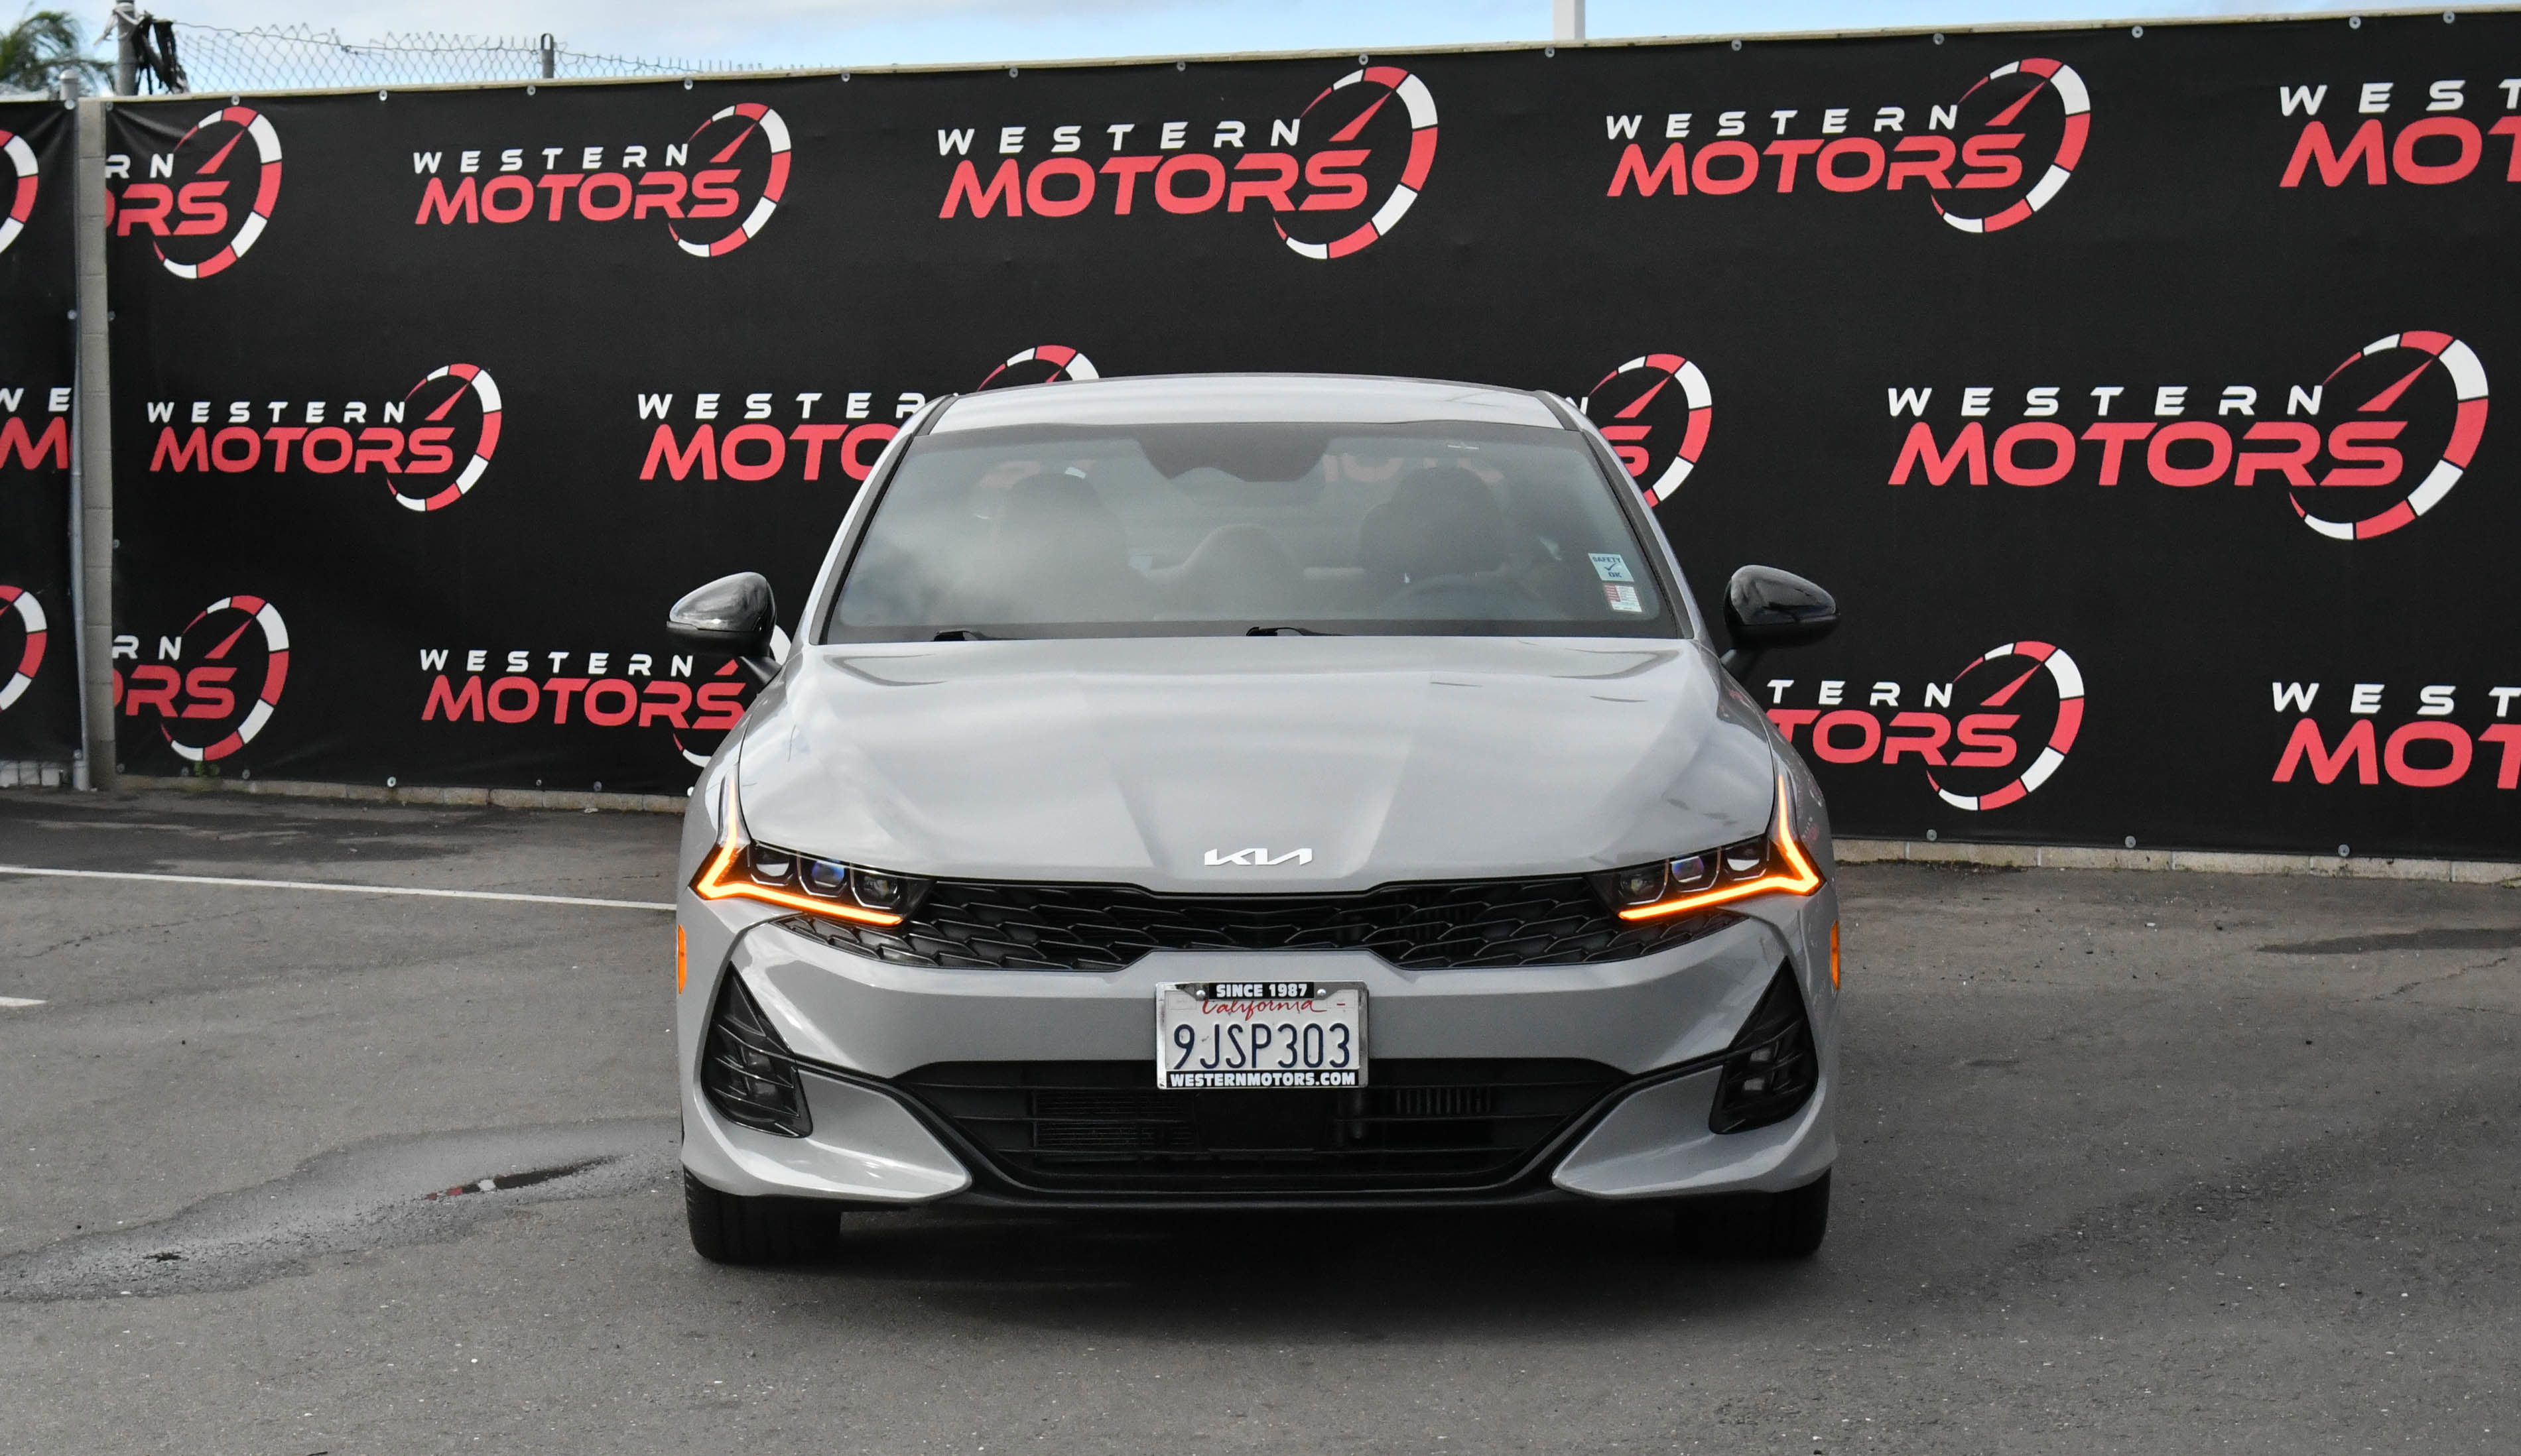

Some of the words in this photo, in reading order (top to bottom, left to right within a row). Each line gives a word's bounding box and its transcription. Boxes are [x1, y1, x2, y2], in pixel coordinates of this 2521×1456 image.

[938, 119, 1301, 155] WESTERN
[1606, 105, 1958, 140] WESTERN
[414, 143, 688, 174] WESTERN
[1608, 133, 2026, 197] MOTORS
[417, 168, 741, 225] MOTORS
[940, 150, 1371, 219] MOTORS
[106, 180, 230, 236] RS
[148, 401, 405, 422] WESTERN
[1888, 385, 2323, 416] WESTERN
[150, 426, 455, 473] MOTORS
[1889, 421, 2408, 487] MOTORS
[420, 649, 693, 678] WESTERN
[113, 664, 237, 719] RS
[421, 674, 745, 730] MOTORS
[1767, 679, 1953, 708] TERN
[2272, 682, 2521, 717] WEST
[2272, 718, 2521, 790] MOT
[1204, 848, 1313, 866] KIA
[1216, 983, 1263, 998] SINCE
[1268, 983, 1307, 998] 1987
[1202, 999, 1326, 1021] California
[1173, 1023, 1350, 1069] 9JSP303
[1169, 1071, 1356, 1087] WESTERNMOTORS.COM
